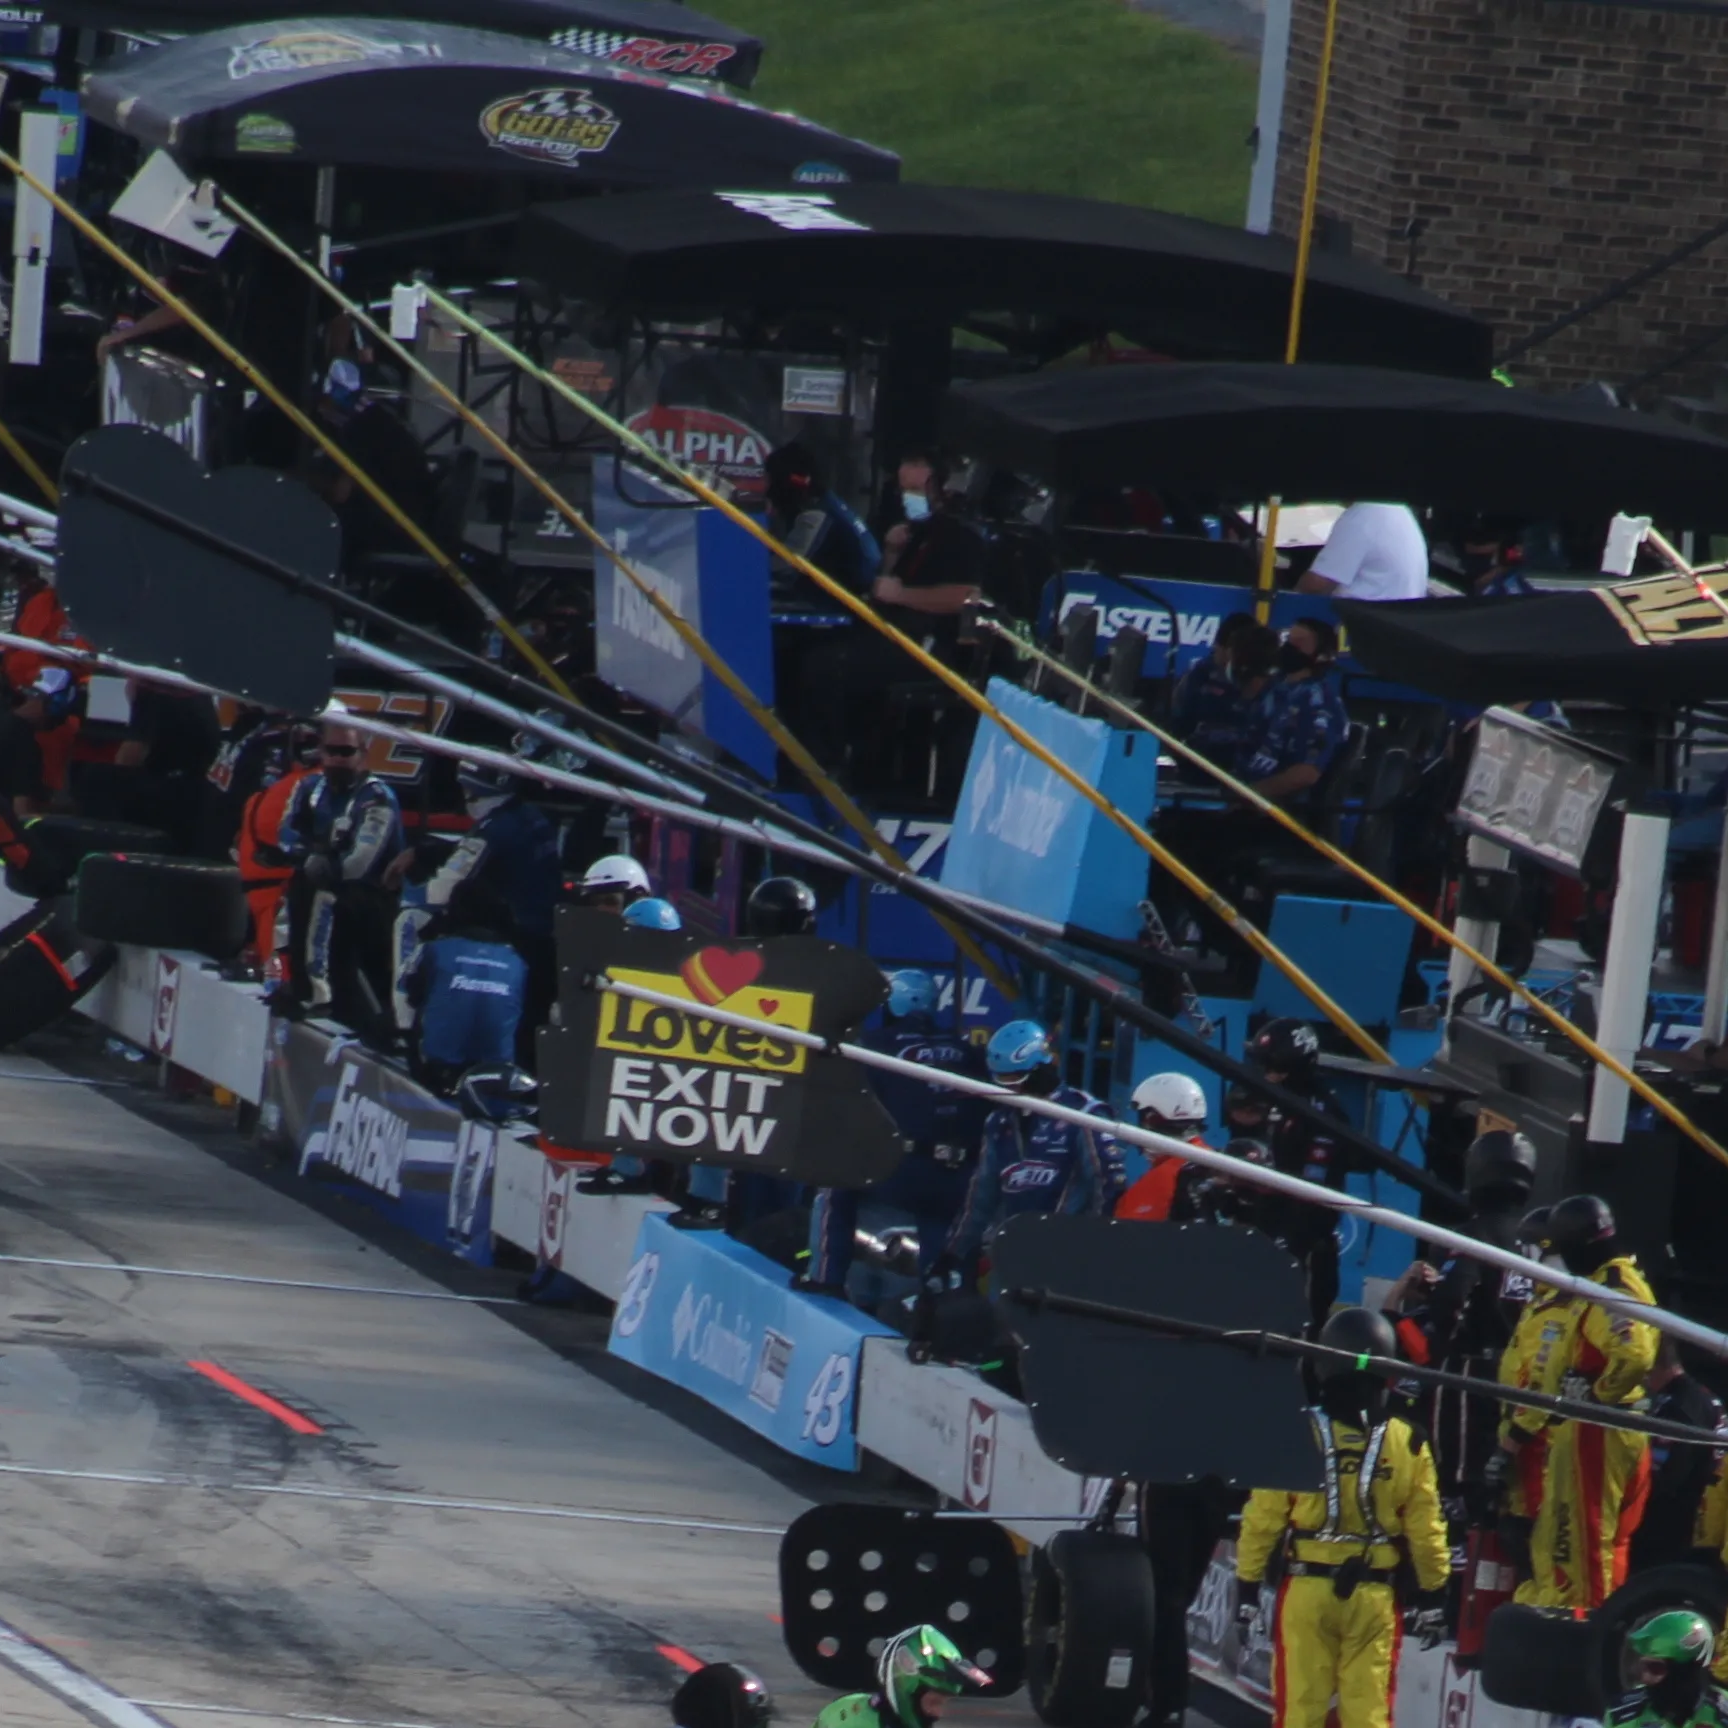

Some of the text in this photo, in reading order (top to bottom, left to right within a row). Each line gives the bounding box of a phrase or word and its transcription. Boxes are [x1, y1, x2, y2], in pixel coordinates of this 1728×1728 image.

[608, 38, 736, 75] RCR
[610, 1056, 784, 1113] EXIT
[605, 1097, 778, 1155] NOW
[801, 1353, 851, 1447] 43
